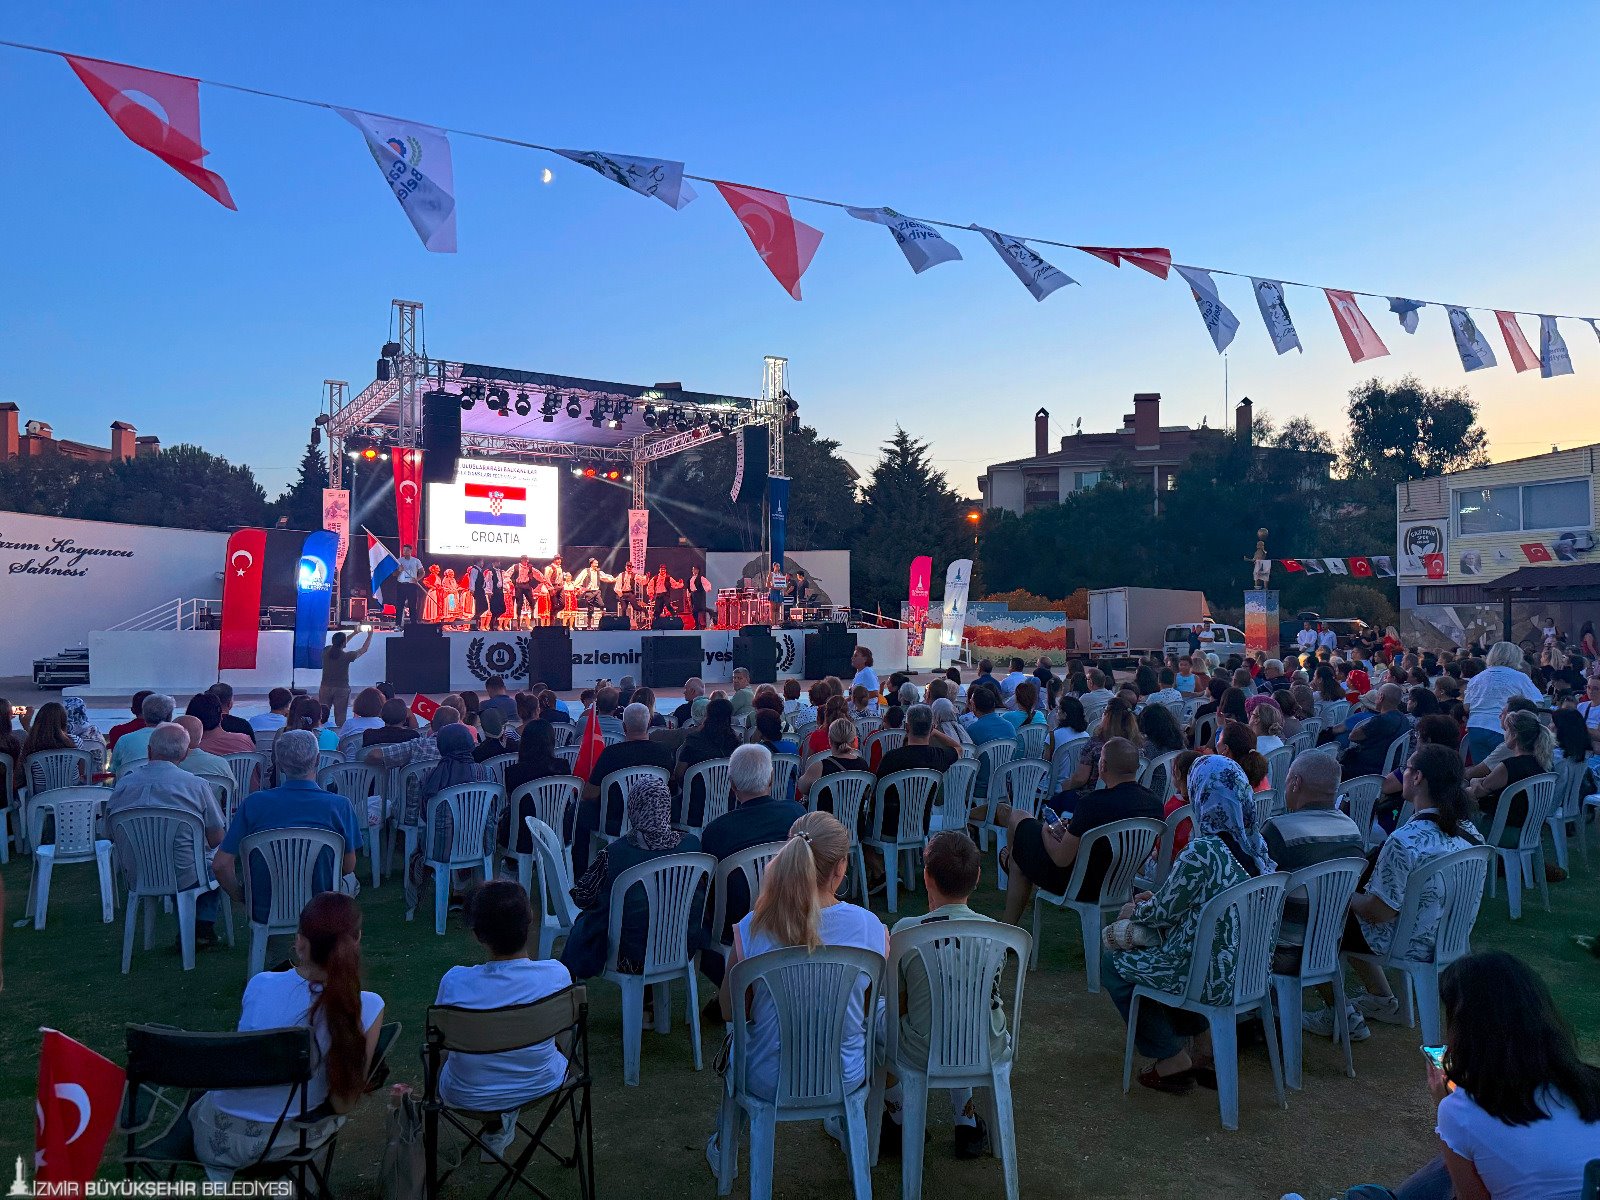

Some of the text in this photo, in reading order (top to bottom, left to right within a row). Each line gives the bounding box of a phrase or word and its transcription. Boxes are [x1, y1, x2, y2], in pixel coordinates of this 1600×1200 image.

[471, 530, 520, 544] CROATIA
[0, 532, 134, 567] azım Koyuncu
[9, 556, 88, 577] Sahnesi
[572, 648, 642, 665] aziemir
